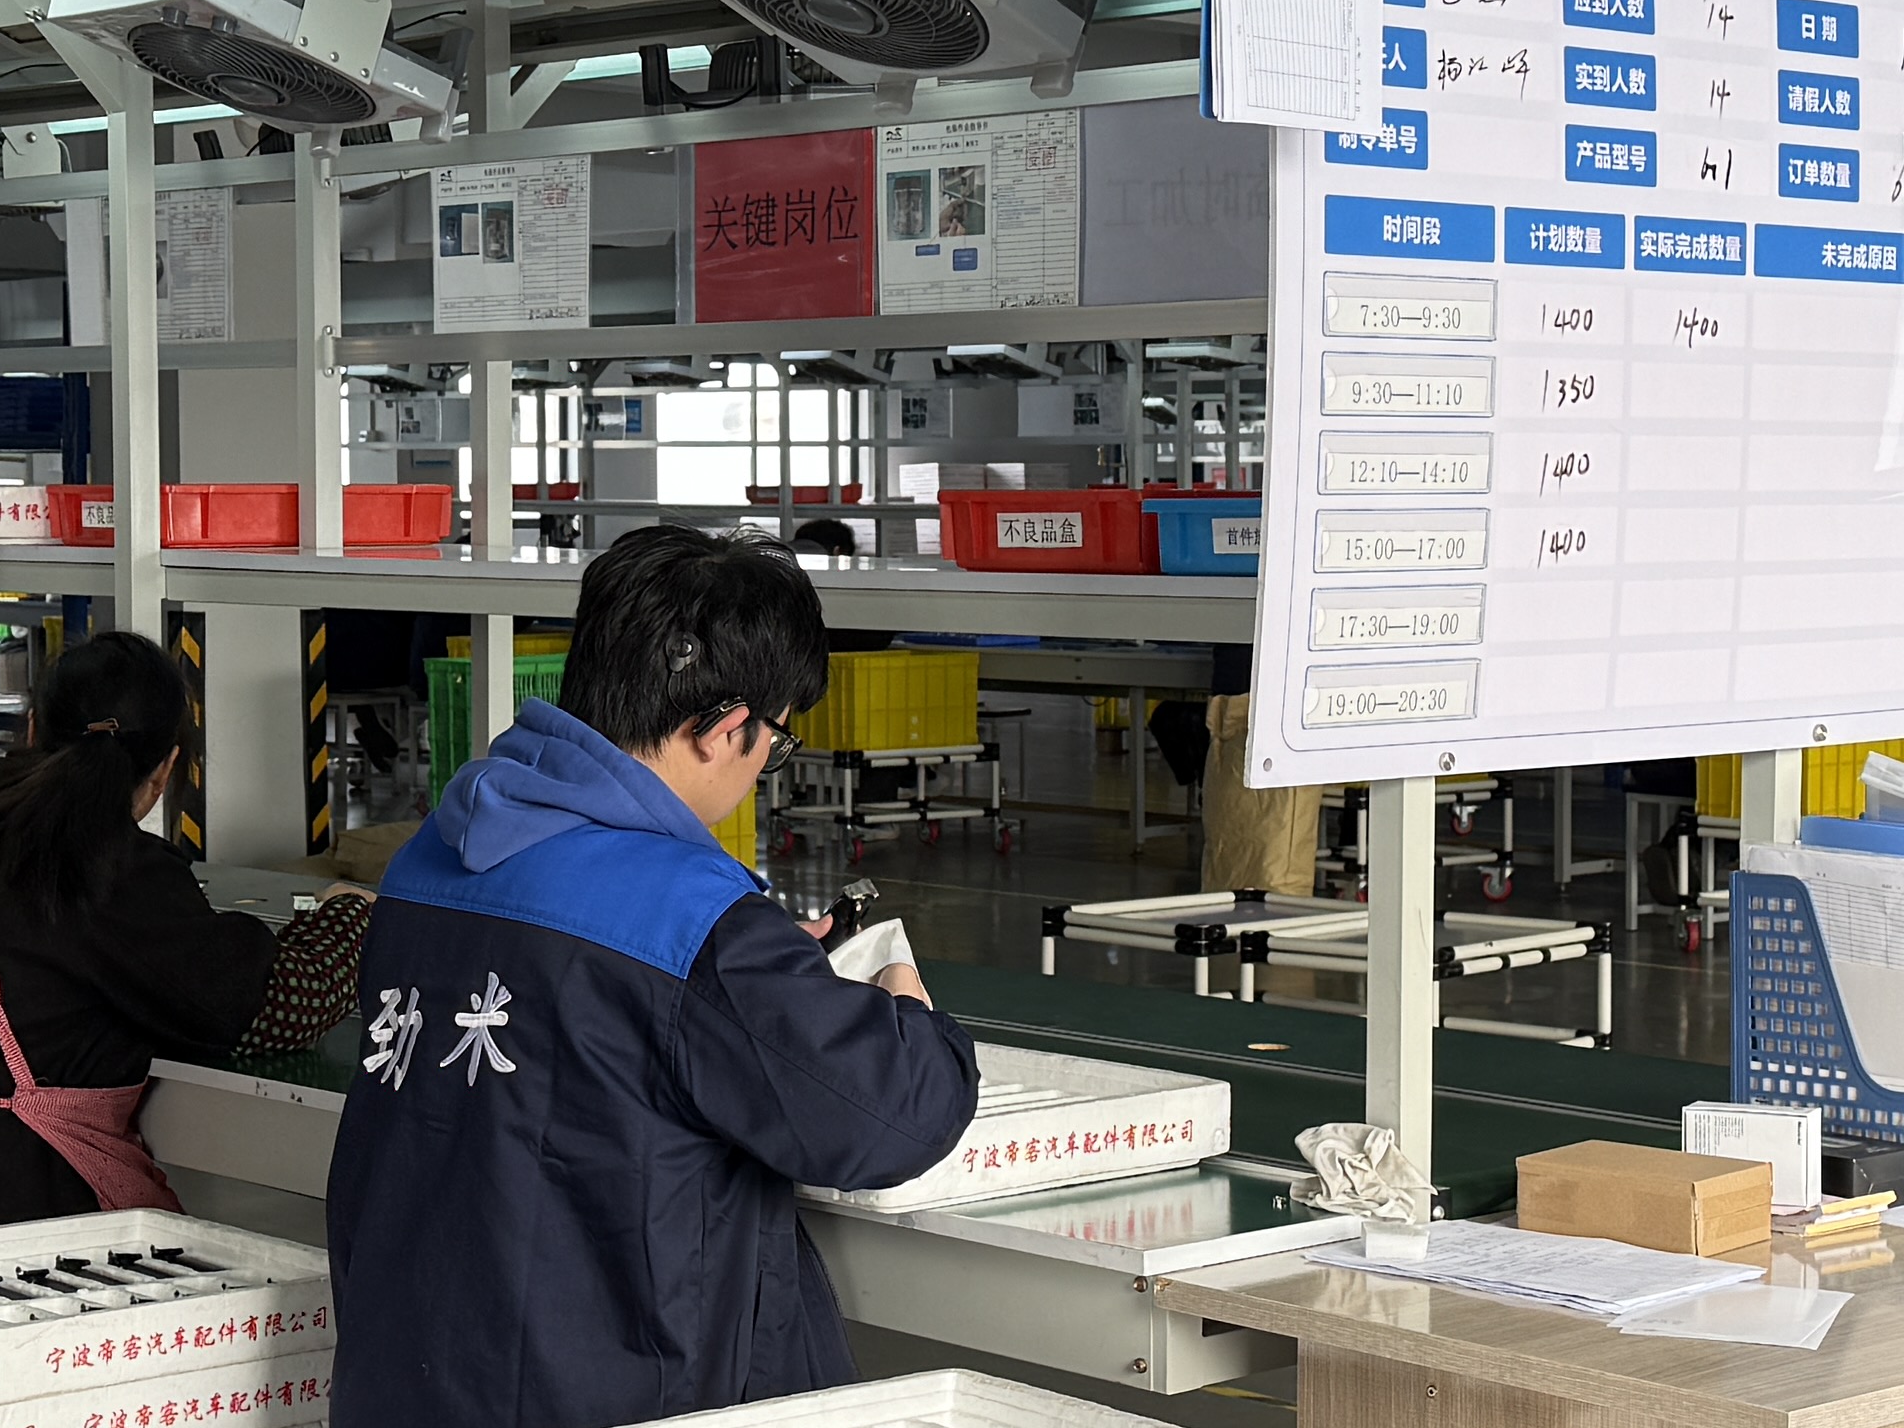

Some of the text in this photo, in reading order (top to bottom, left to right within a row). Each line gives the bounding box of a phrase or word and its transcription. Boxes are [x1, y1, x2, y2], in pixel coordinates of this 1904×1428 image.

[1707, 3, 1734, 40] 14
[1801, 14, 1837, 42] 日期
[1575, 63, 1646, 96] 实到人数
[1710, 78, 1731, 119] 14
[1788, 85, 1851, 115] 请假人数
[1576, 139, 1647, 173] 产品型号
[1788, 159, 1851, 189] 订单数量
[703, 185, 859, 252] 关键岗位
[1383, 214, 1441, 246] 时间段
[1530, 223, 1602, 254] 计划数量
[1640, 230, 1743, 262] 实际完成数量
[1822, 242, 1897, 271] 未完成原因
[1541, 303, 1593, 335] 1400
[1673, 307, 1718, 348] 1400
[1542, 369, 1594, 412] 1350
[1539, 452, 1590, 497] 1400
[1002, 518, 1078, 543] 不良品盒
[1537, 529, 1587, 569] 1400
[363, 972, 517, 1092] 劲米
[962, 1119, 1194, 1173] 宁波帝客汽车配件有限公司
[48, 1306, 328, 1373] 宁波帝客汽车配件有限公司
